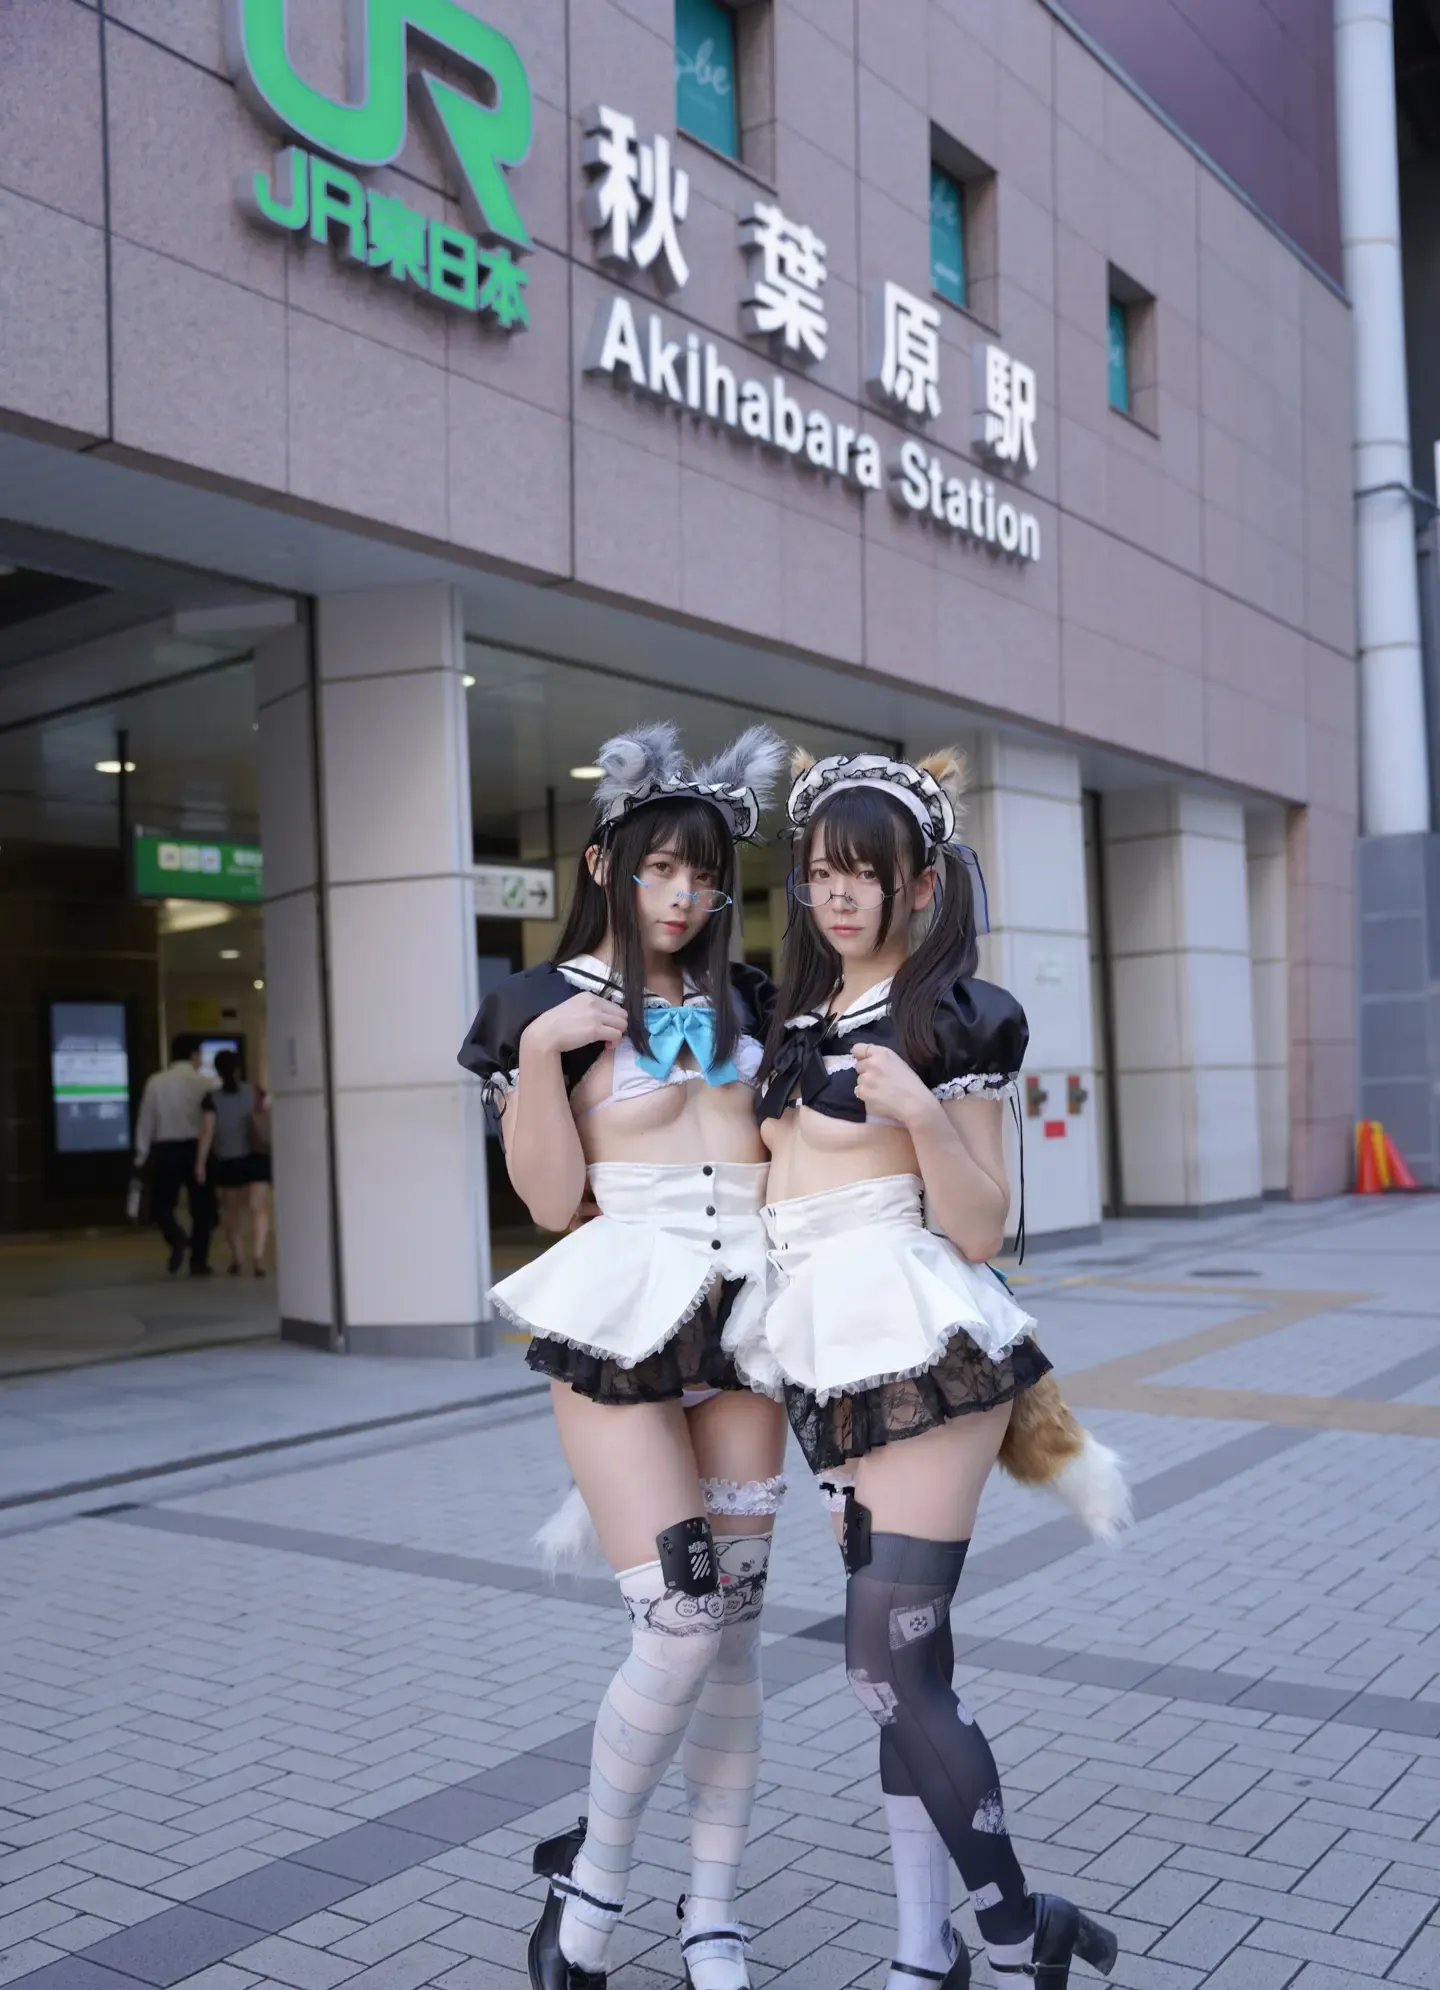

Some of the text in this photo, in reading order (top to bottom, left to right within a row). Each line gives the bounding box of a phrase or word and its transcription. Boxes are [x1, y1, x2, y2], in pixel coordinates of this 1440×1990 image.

[253, 145, 530, 328] JR東日本
[597, 104, 1039, 472] 秋葉原駅
[600, 296, 1041, 563] Akihabara Station
